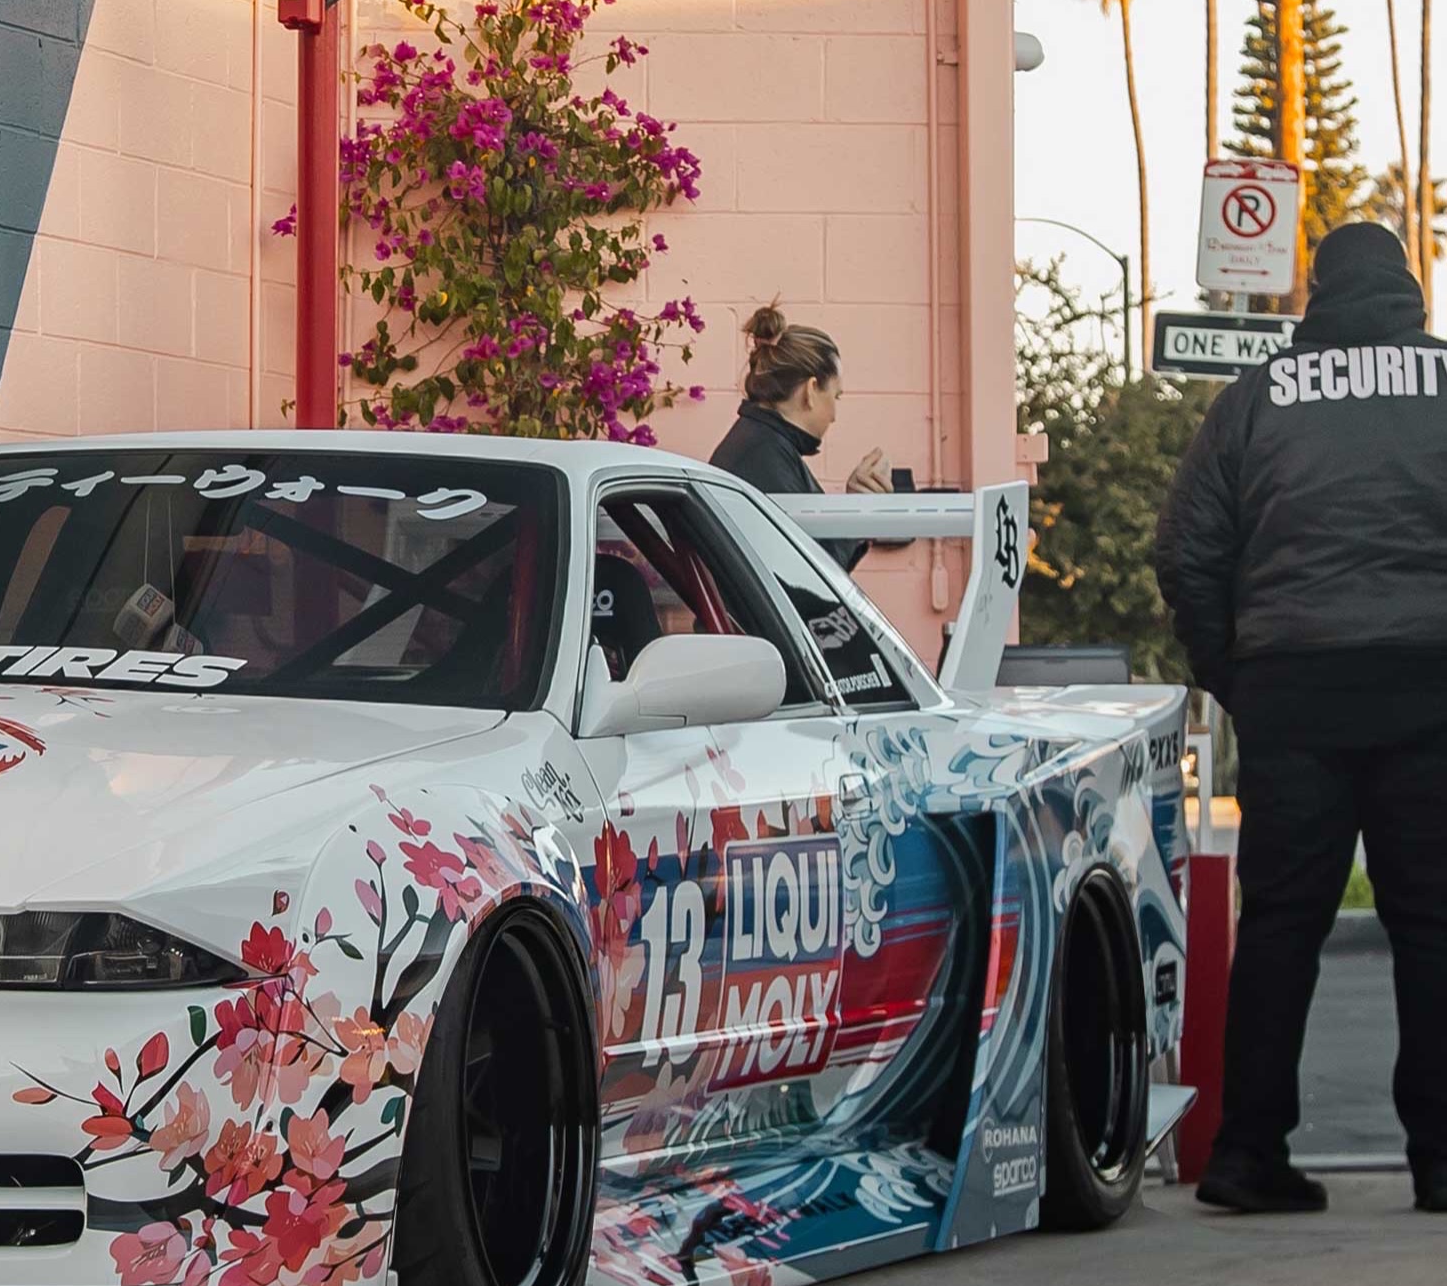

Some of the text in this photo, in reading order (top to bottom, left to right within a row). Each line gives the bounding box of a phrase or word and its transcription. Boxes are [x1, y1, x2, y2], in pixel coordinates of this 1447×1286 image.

[1174, 332, 1224, 356] ONE
[1269, 345, 1447, 407] SECURIT
[731, 848, 839, 963] LIQUI
[640, 880, 706, 1068] 13
[716, 970, 839, 1081] MOLY
[984, 1124, 1038, 1148] ROHANA
[993, 1155, 1037, 1192] sparco
